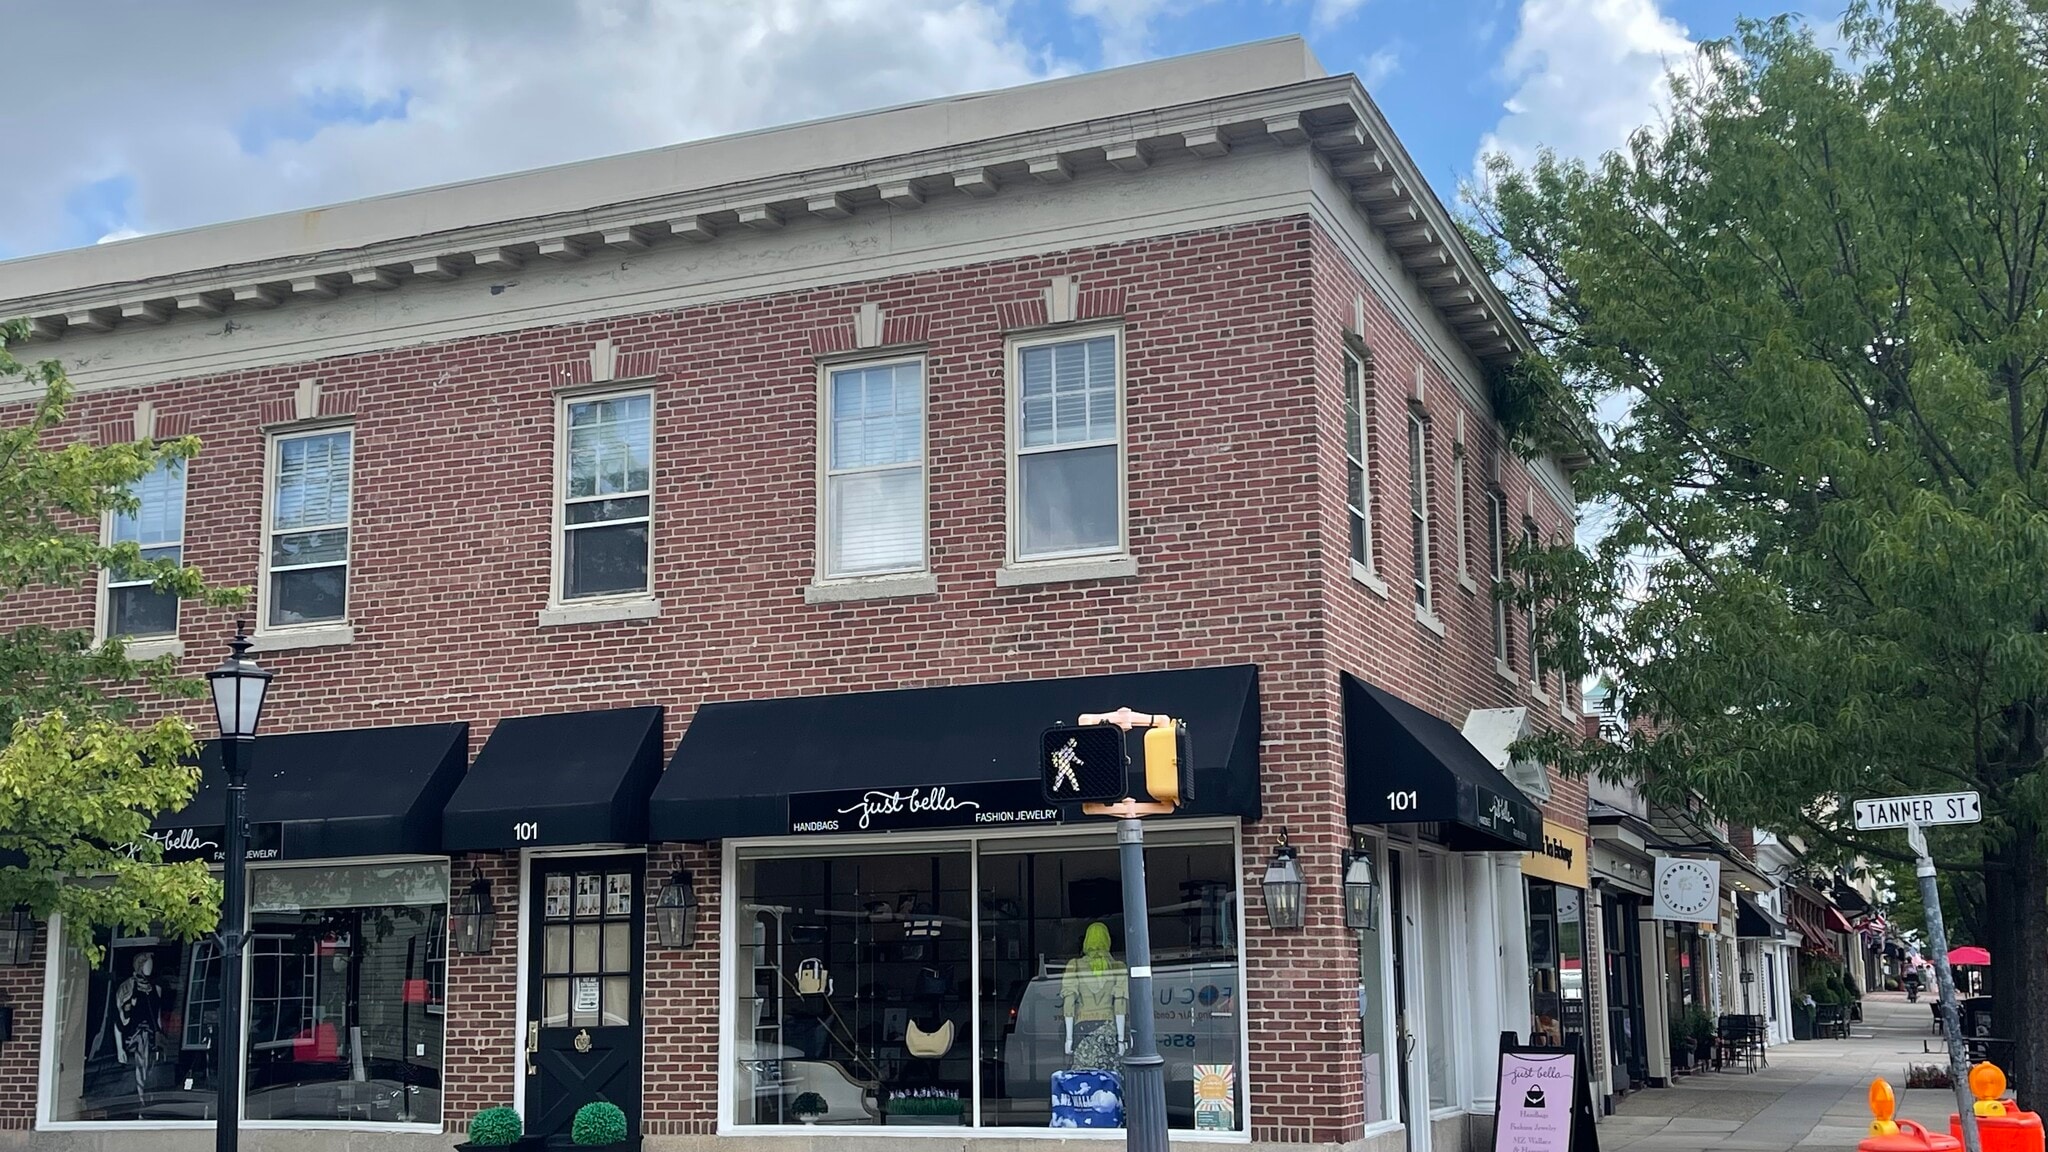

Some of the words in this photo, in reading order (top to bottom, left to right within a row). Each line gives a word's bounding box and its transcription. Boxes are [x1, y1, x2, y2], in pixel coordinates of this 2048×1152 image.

[838, 791, 903, 828] just
[909, 787, 980, 812] bella
[1386, 790, 1417, 811] 101
[975, 811, 1014, 823] FASHION
[1015, 809, 1058, 821] JEWELRY
[1867, 800, 1934, 824] TANNER
[1946, 798, 1965, 819] ST
[513, 822, 538, 840] 101
[793, 820, 839, 832] HANDBAGS
[164, 828, 218, 850] bella
[245, 849, 278, 859] JEWELRY
[1503, 1067, 1534, 1085] just
[1537, 1067, 1574, 1079] bella
